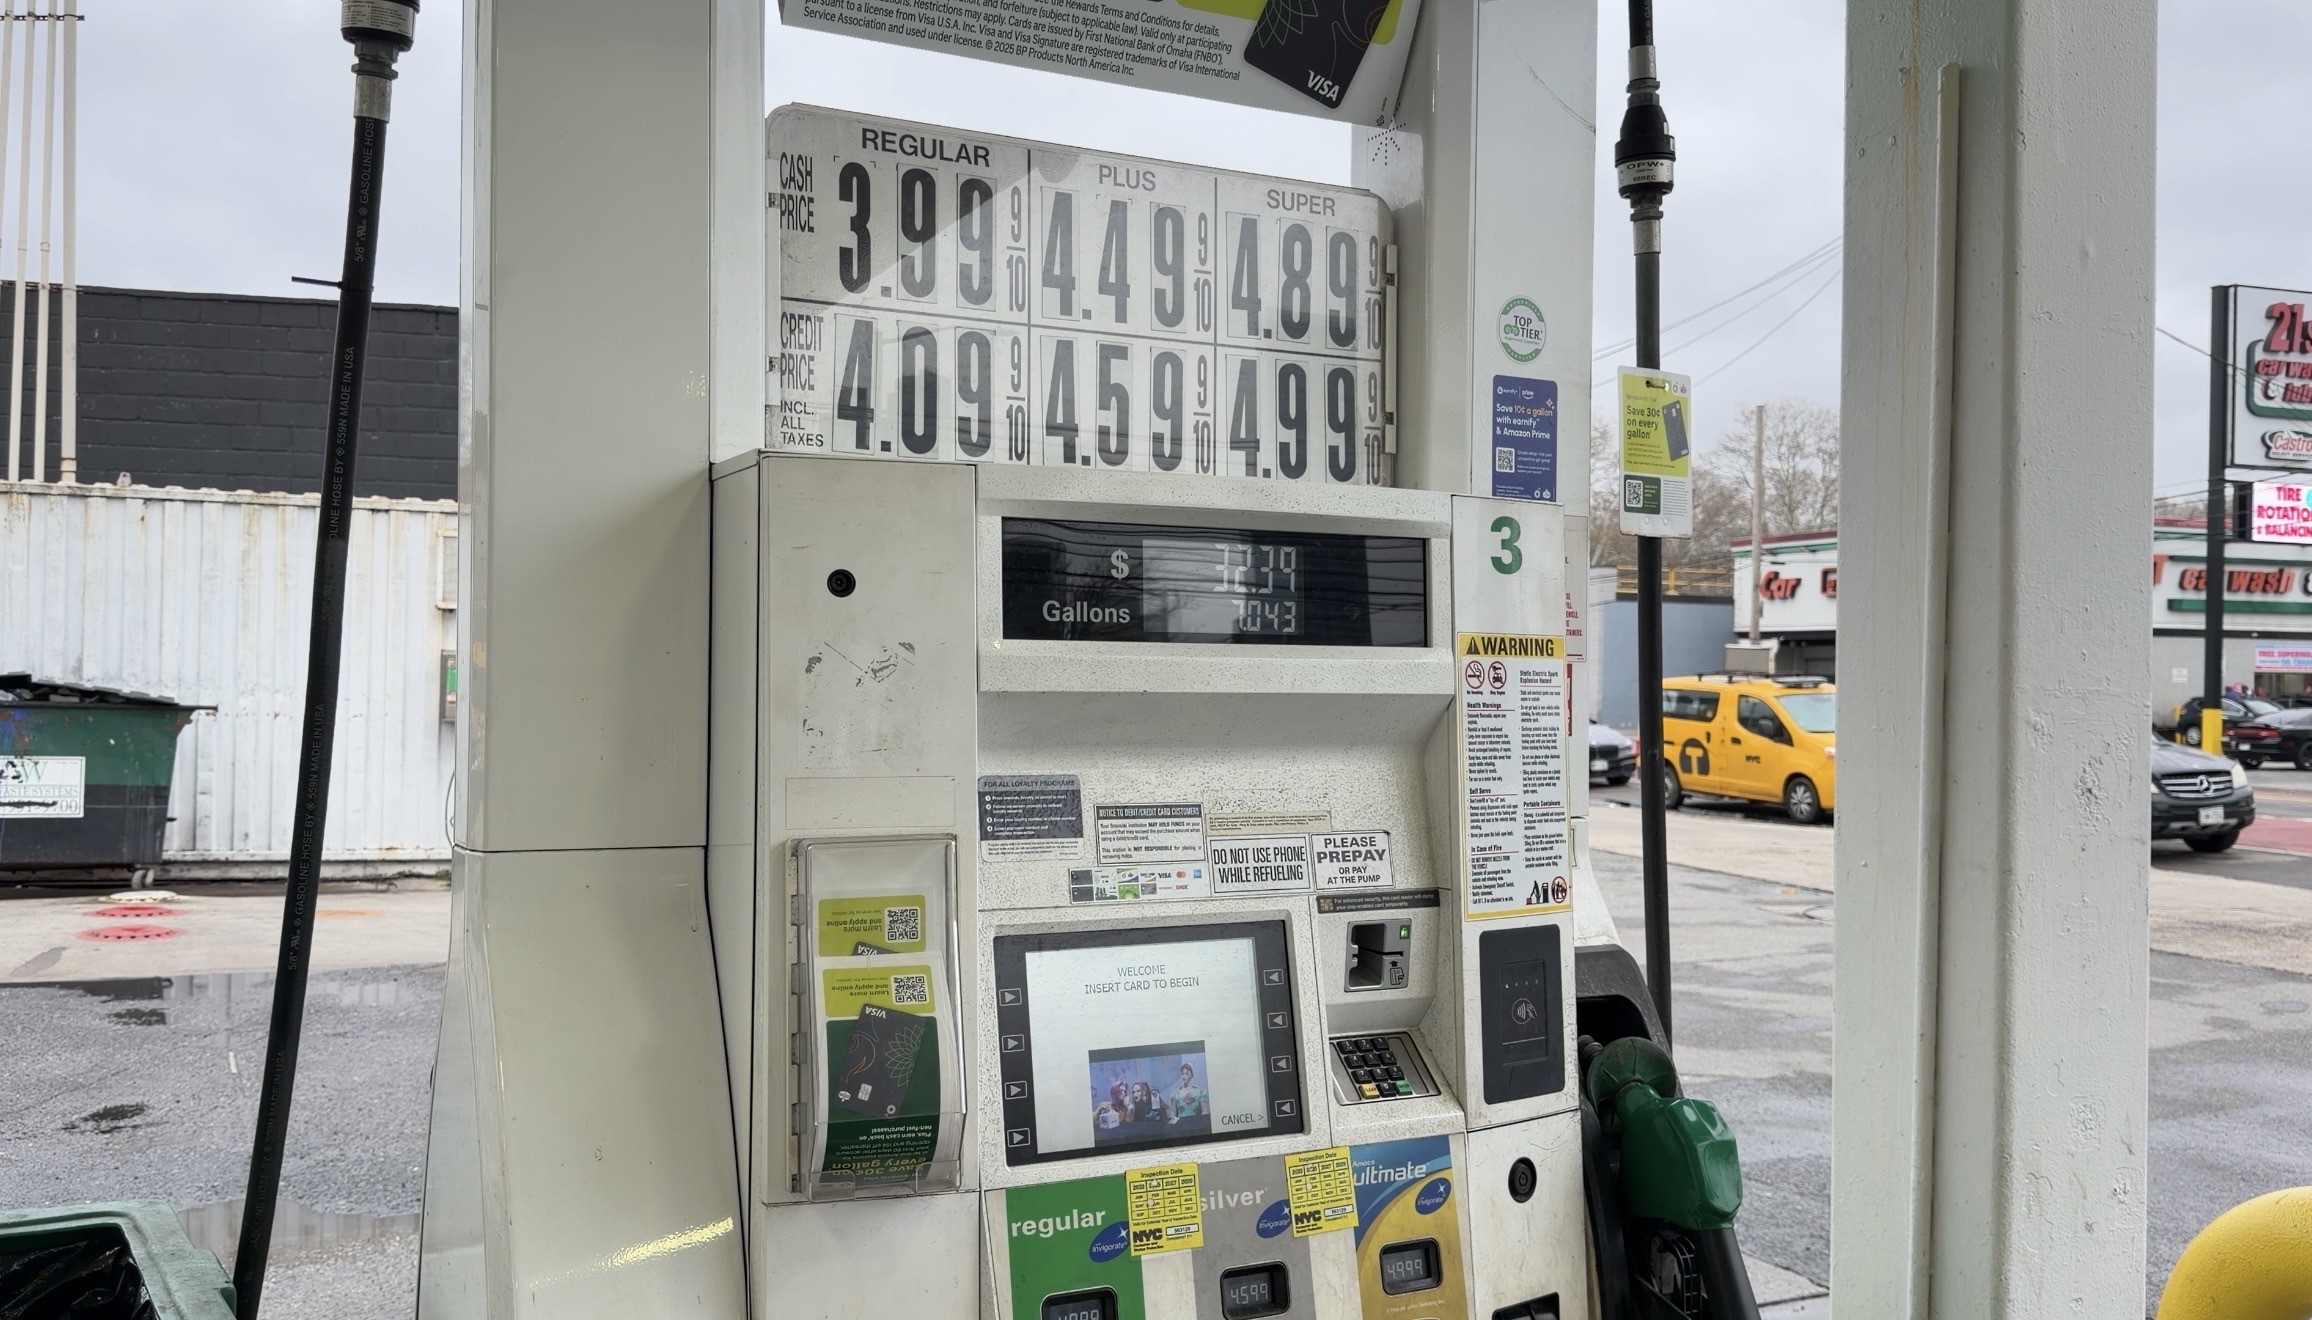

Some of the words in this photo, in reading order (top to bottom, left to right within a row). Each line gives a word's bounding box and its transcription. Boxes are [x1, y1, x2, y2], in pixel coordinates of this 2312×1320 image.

[1000, 0, 1037, 16] forfeiture
[1039, 7, 1070, 24] (subject
[1081, 15, 1120, 32] applicable
[1141, 27, 1158, 38] Valid
[1160, 30, 1176, 44] only
[1186, 35, 1232, 54] participating
[1101, 5, 1123, 18] Terms
[1141, 12, 1180, 29] Conditions
[804, 7, 835, 22] Service
[838, 13, 885, 31] Association
[906, 25, 925, 38] used
[928, 29, 951, 42] under
[954, 34, 983, 48] license.
[994, 42, 1014, 54] 2025
[1016, 46, 1027, 56] BP
[1029, 48, 1063, 63] Products
[1066, 55, 1087, 67] North
[1089, 59, 1120, 73] America
[864, 3, 893, 18] license
[896, 9, 915, 22] from
[919, 13, 935, 25] Visa
[937, 17, 960, 30] U.S.A.
[980, 25, 995, 36] Visa
[1015, 32, 1030, 43] Visa
[1033, 35, 1068, 52] Signature
[1085, 44, 1123, 62] registered
[1125, 51, 1167, 67] trademarks
[1179, 61, 1193, 72] Visa
[1195, 64, 1239, 80] International
[965, 10, 980, 21] may
[983, 11, 1006, 26] apply.
[1009, 16, 1032, 29] Cards
[1048, 23, 1072, 36] issued
[1086, 29, 1102, 43] First
[1104, 34, 1135, 48] National
[1137, 40, 1154, 52] Bank
[1166, 45, 1192, 58] Omaha
[1308, 69, 1340, 101] VISA
[861, 127, 990, 168] REGULAR
[360, 149, 373, 204] GASOLINE
[779, 151, 813, 193] CASH
[1099, 164, 1157, 192] PLUS
[779, 192, 815, 233] PRICE
[1266, 188, 1336, 217] SUPER
[838, 161, 994, 306] 3.99
[1042, 191, 1185, 329] 4.49
[1231, 216, 1358, 348] 4.89
[780, 311, 824, 351] CREDIT
[1513, 315, 1532, 328] TOP
[344, 347, 355, 369] USA
[2256, 358, 2287, 376] car
[343, 372, 352, 383] IN
[780, 352, 815, 392] PRICE
[837, 318, 992, 458] 4.09
[340, 386, 352, 416] MADE
[780, 400, 815, 416] INCL.
[1045, 339, 1184, 472] 4.59
[1496, 403, 1513, 413] Save
[1532, 408, 1553, 418] gallon
[1626, 405, 1645, 416] Save
[1646, 407, 1660, 418] 30¢
[336, 418, 348, 444] 559N
[780, 416, 806, 431] ALL
[1229, 358, 1357, 483] 4.99
[1496, 416, 1512, 425] with
[1627, 419, 1636, 428] on
[1638, 419, 1659, 432] every
[780, 431, 824, 448] TAXES
[1496, 426, 1502, 435] &
[1503, 427, 1531, 438] Amazon
[1532, 430, 1550, 440] Prime
[334, 459, 344, 474] BY
[331, 472, 343, 506] HOSE
[2276, 486, 2302, 502] TIRE
[1490, 515, 1523, 575] 3
[1110, 549, 1130, 581] $
[1760, 570, 1802, 600] Car
[2227, 567, 2296, 594] wash
[1042, 600, 1131, 624] Gallons
[1481, 636, 1554, 658] WARNING
[1324, 837, 1376, 848] PLEASE
[1213, 849, 1227, 865] DO
[1230, 848, 1249, 864] NOT
[1253, 847, 1271, 863] USE
[1274, 846, 1306, 862] PHONE
[1317, 850, 1386, 863] PREPAY
[1219, 867, 1251, 883] WHILE
[1254, 865, 1303, 882] REFUELING
[1327, 876, 1338, 884] AT
[1340, 876, 1355, 884] THE
[1358, 875, 1380, 883] PUMP
[1352, 866, 1367, 874] PAY
[849, 918, 867, 926] apply
[1118, 965, 1166, 977] WELCOME
[1084, 983, 1120, 995] INSERT
[1123, 980, 1151, 991] CARD
[1153, 979, 1167, 989] TO
[1170, 977, 1199, 988] BEGIN
[865, 1006, 887, 1019] VISA
[1221, 1113, 1255, 1125] CANCEL
[1141, 1170, 1169, 1178] Inspection
[1353, 1160, 1375, 1168] Amoco
[1353, 1162, 1427, 1187] ultimate
[1200, 1187, 1265, 1212] silver
[1011, 1209, 1106, 1238] regular
[1294, 1210, 1321, 1225] NYC
[1133, 1228, 1162, 1243] NYC
